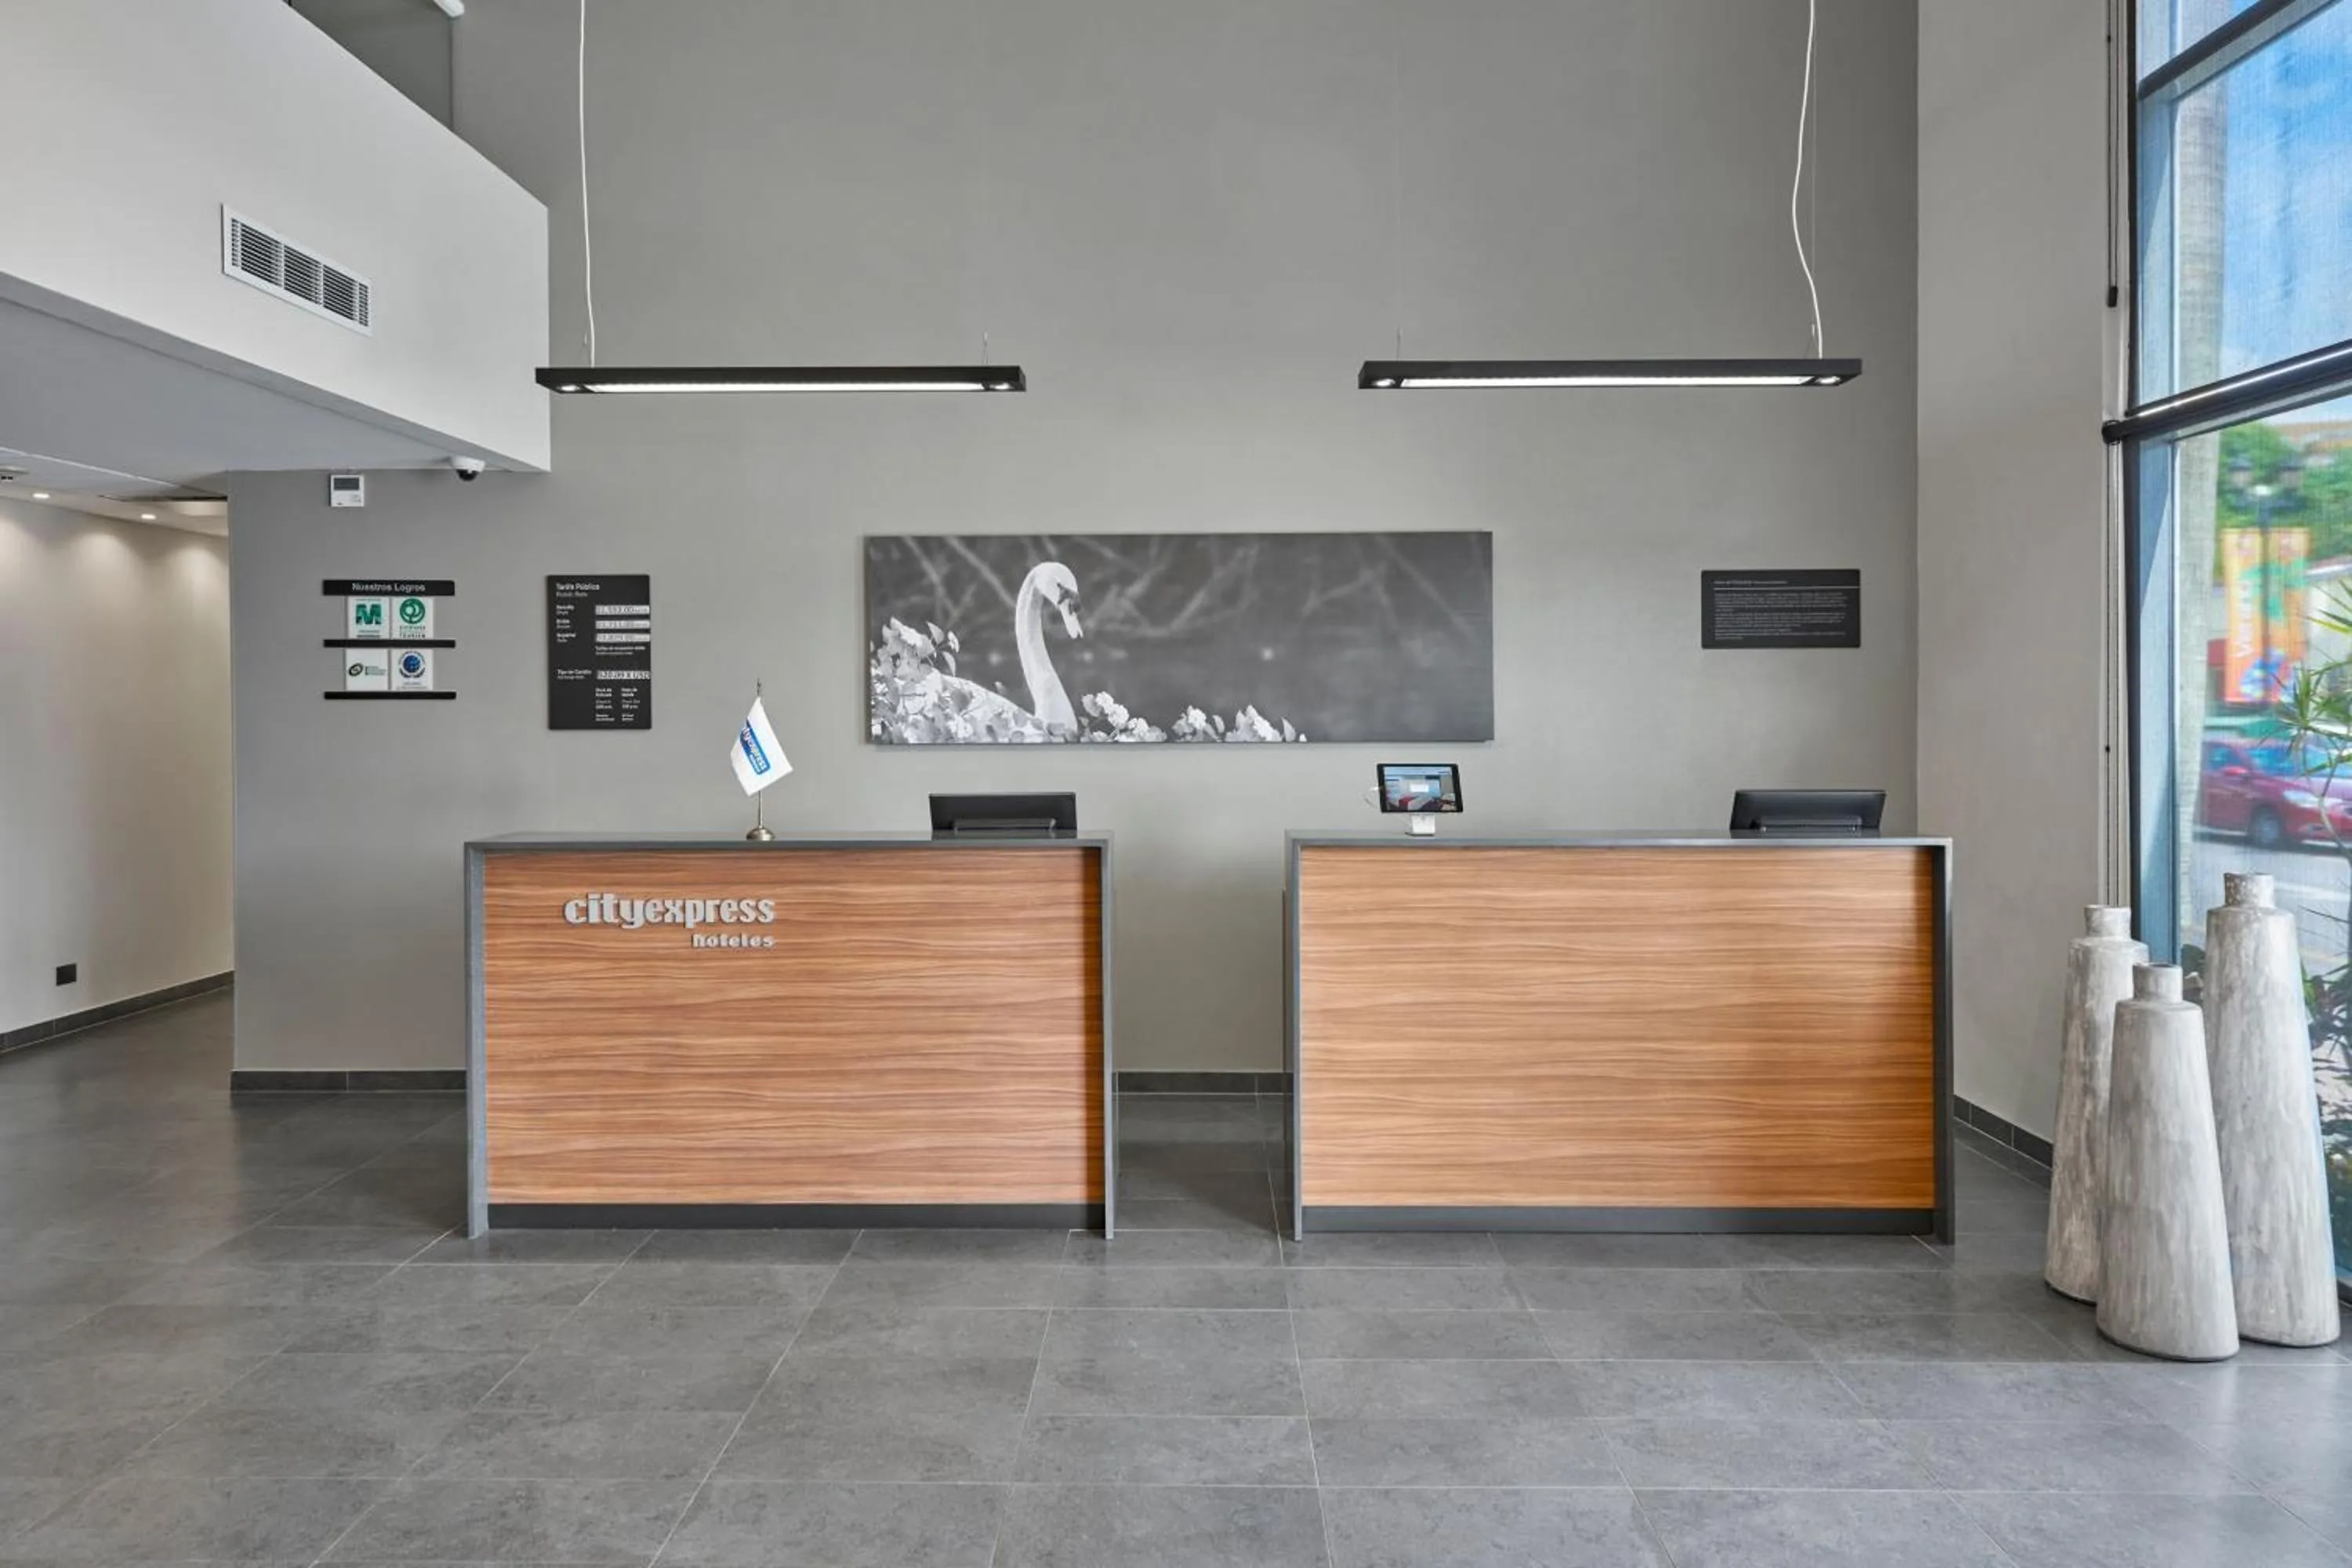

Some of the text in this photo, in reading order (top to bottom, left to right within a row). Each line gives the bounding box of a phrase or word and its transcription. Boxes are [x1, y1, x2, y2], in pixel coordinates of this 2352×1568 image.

[352, 583, 425, 593] Nuestros Logros
[564, 893, 775, 928] cityexpress
